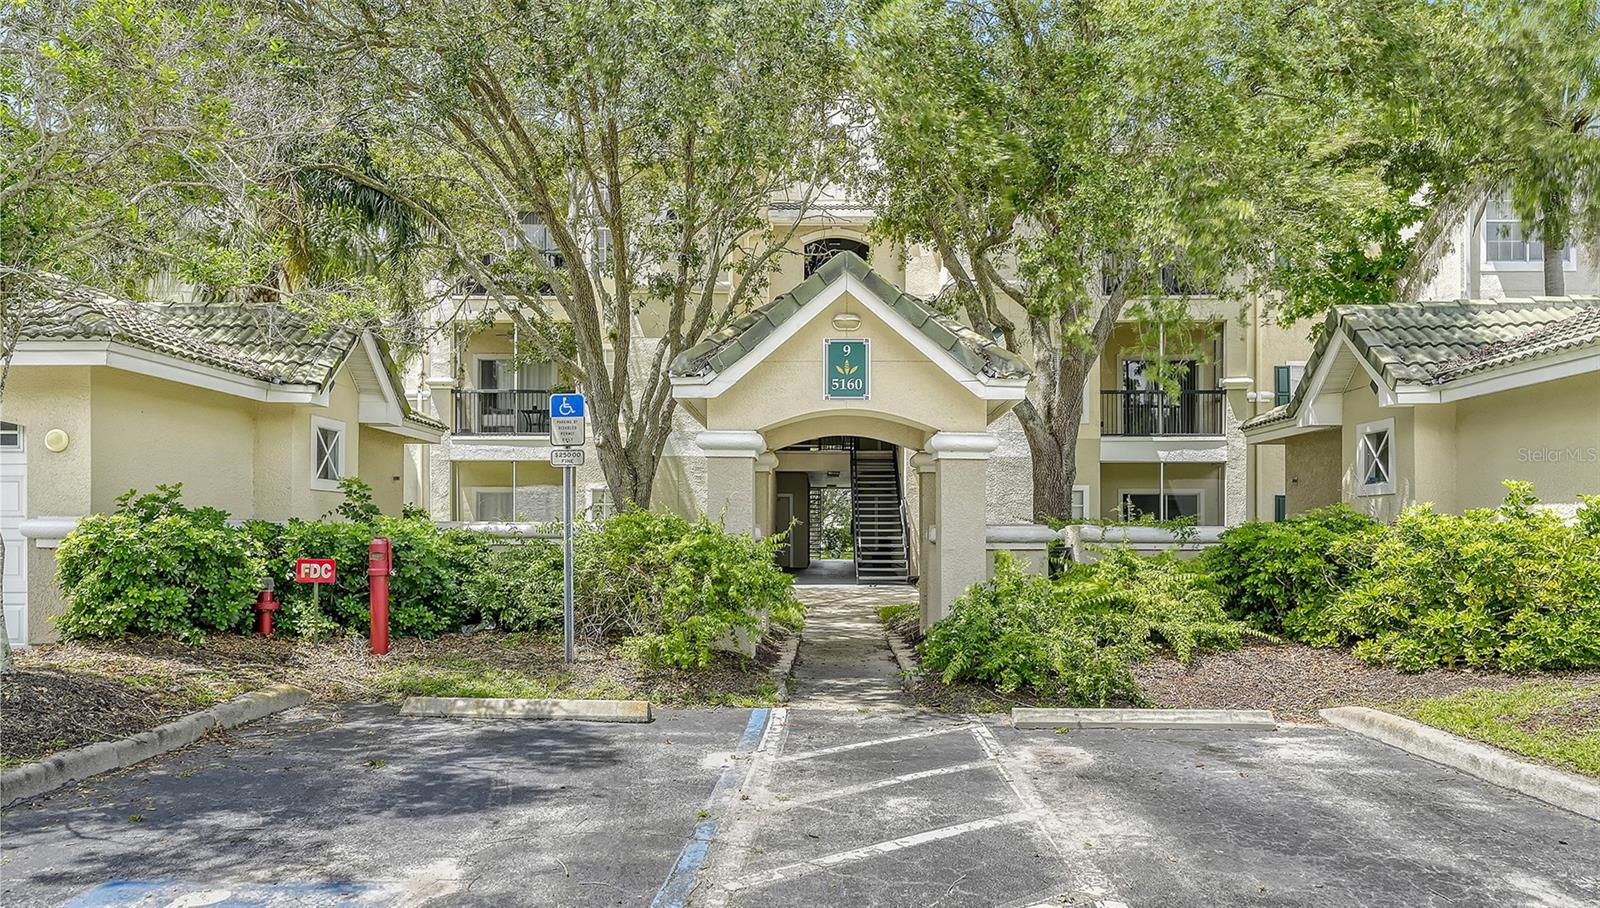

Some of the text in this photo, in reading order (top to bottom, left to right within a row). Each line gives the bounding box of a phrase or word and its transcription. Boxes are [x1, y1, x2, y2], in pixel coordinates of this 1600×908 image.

[843, 344, 851, 357] 9
[831, 378, 863, 390] 5160
[301, 563, 332, 579] FDC
